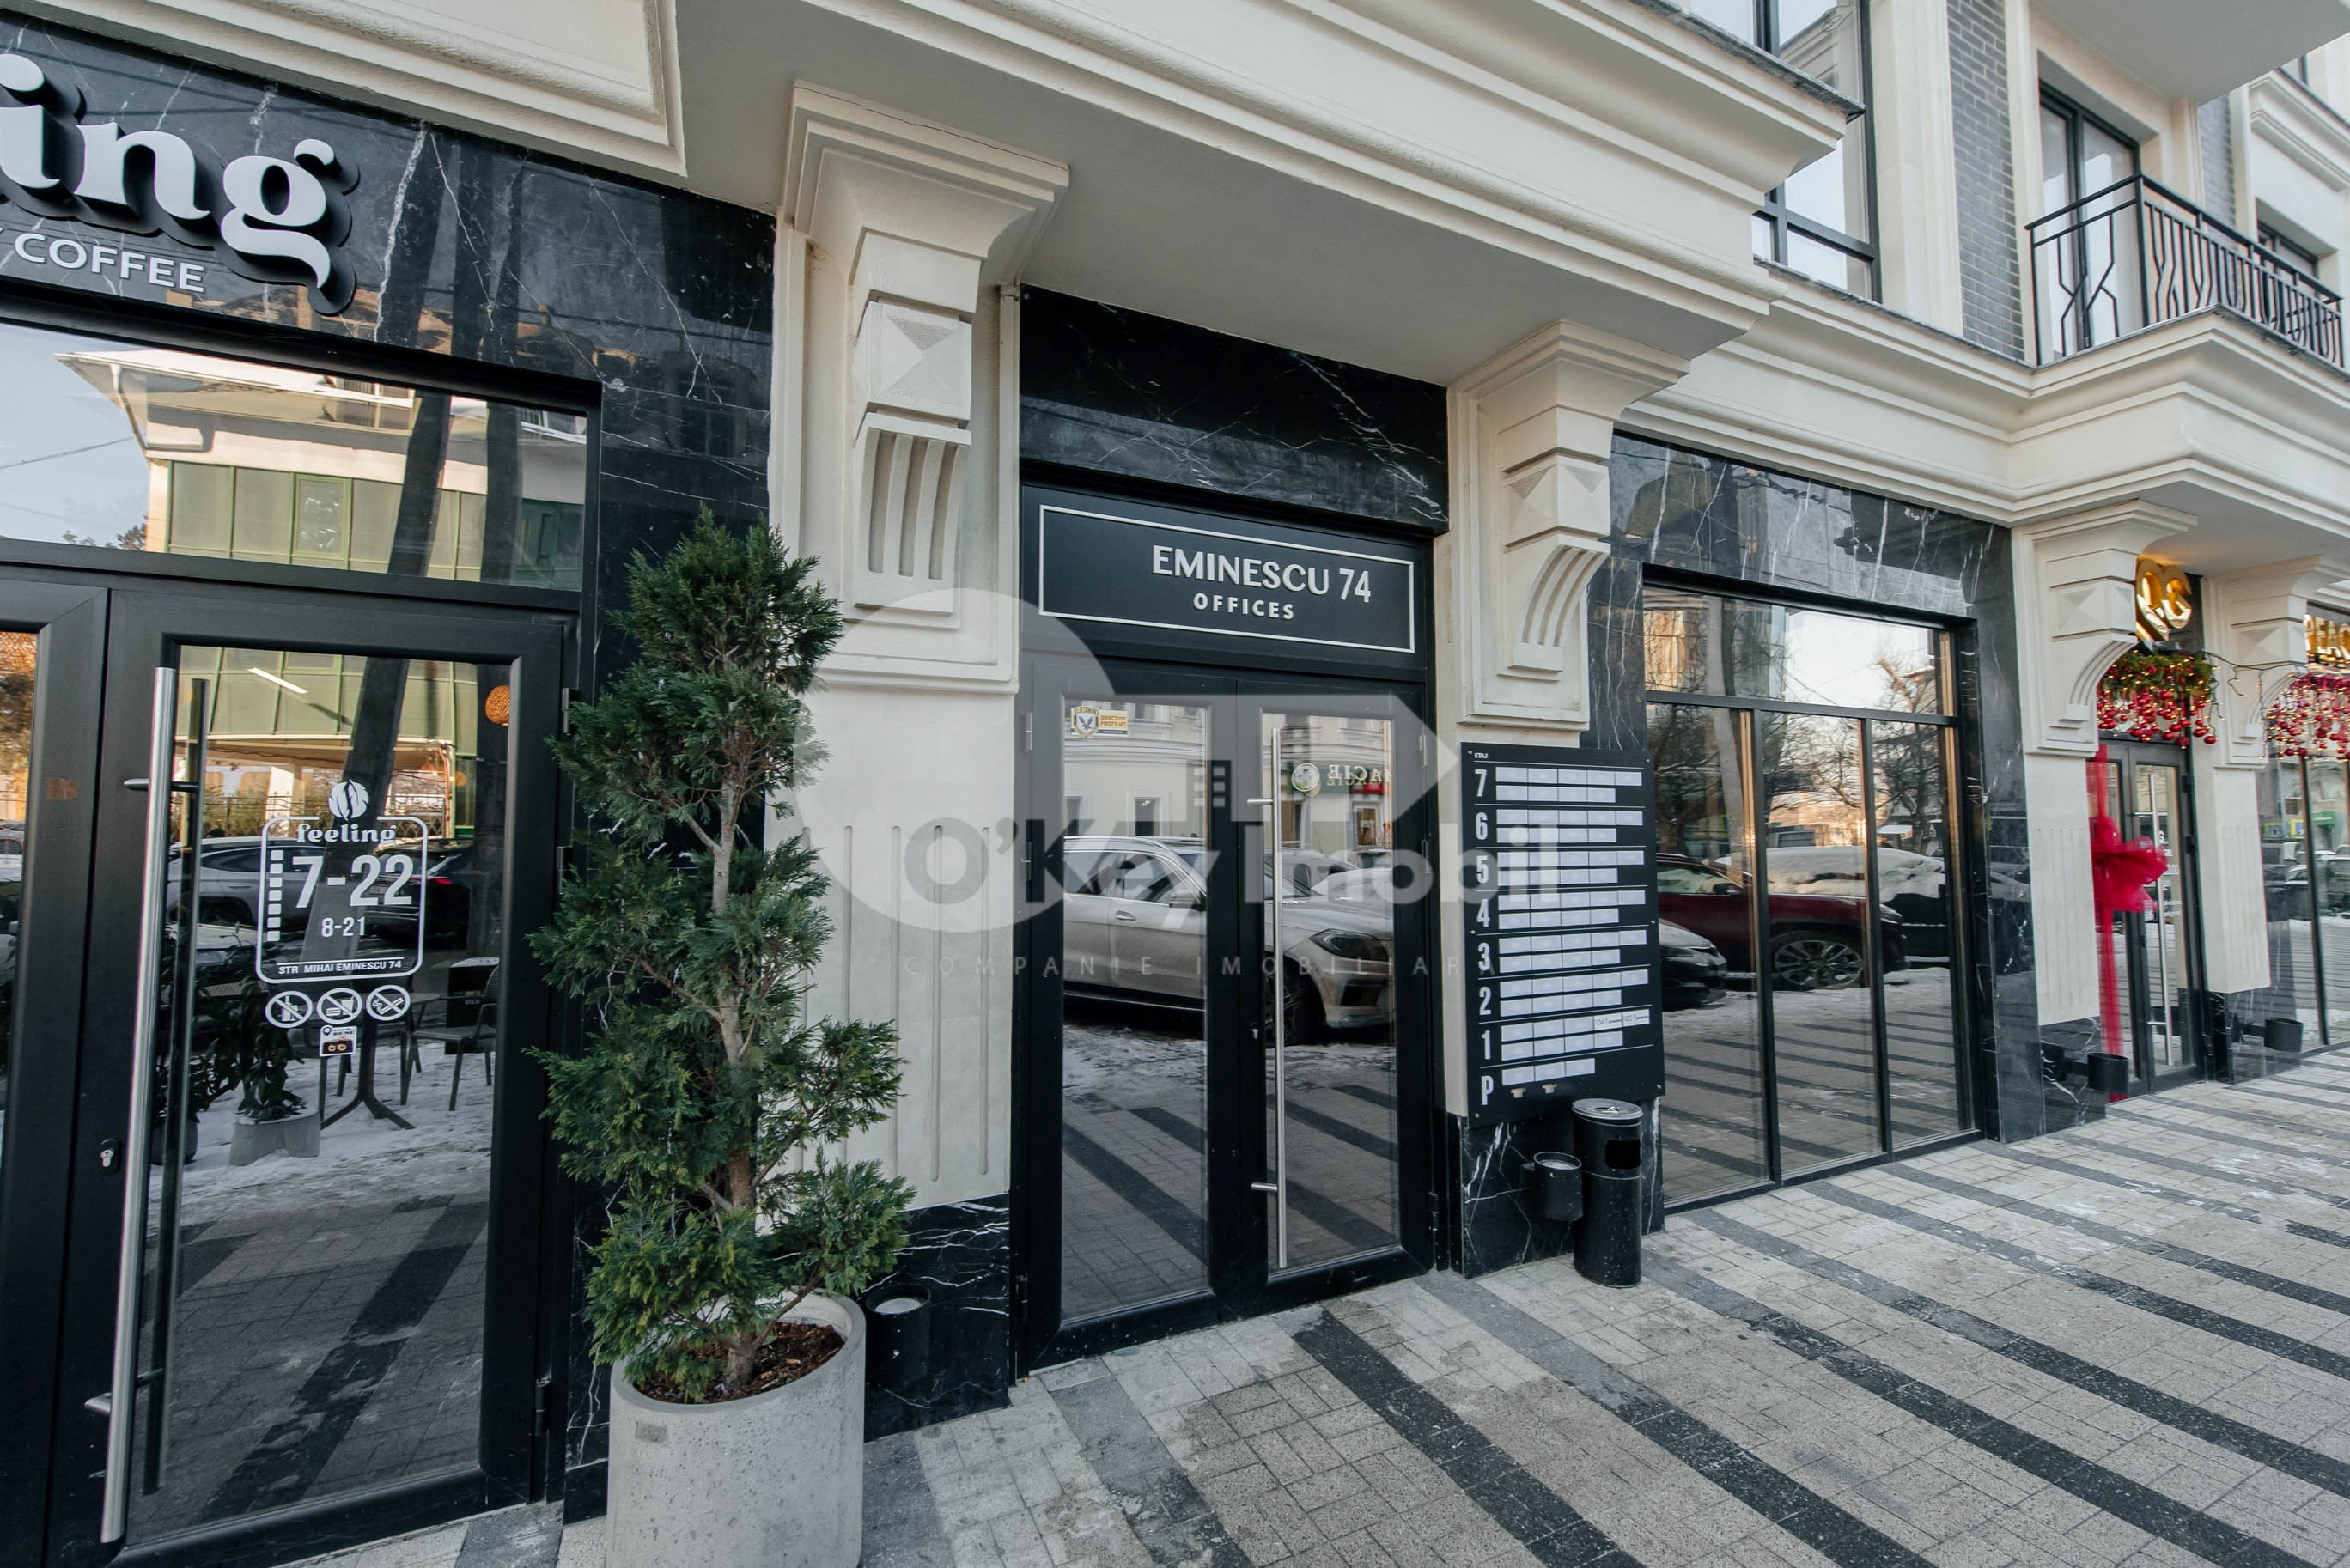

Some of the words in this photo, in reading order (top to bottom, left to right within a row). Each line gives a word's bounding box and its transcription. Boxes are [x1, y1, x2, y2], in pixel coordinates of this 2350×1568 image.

[15, 234, 206, 293] COFFEE
[1153, 544, 1330, 595] EMINESCU
[1338, 567, 1371, 603] 74
[1193, 593, 1294, 619] OFFICES
[1475, 769, 1487, 797] 7
[297, 824, 397, 846] feeling
[1476, 811, 1488, 841] 6
[292, 854, 414, 909] 7-22
[1476, 855, 1489, 884] 5
[1476, 896, 1490, 927] 4
[321, 916, 366, 938] 8-21
[303, 963, 334, 974] MIHAI
[336, 961, 387, 972] EMINESCU
[388, 960, 402, 969] 74
[1477, 942, 1491, 972] 3
[1479, 986, 1492, 1016] 2
[1482, 1030, 1492, 1060] 1
[1481, 1075, 1494, 1105] P
